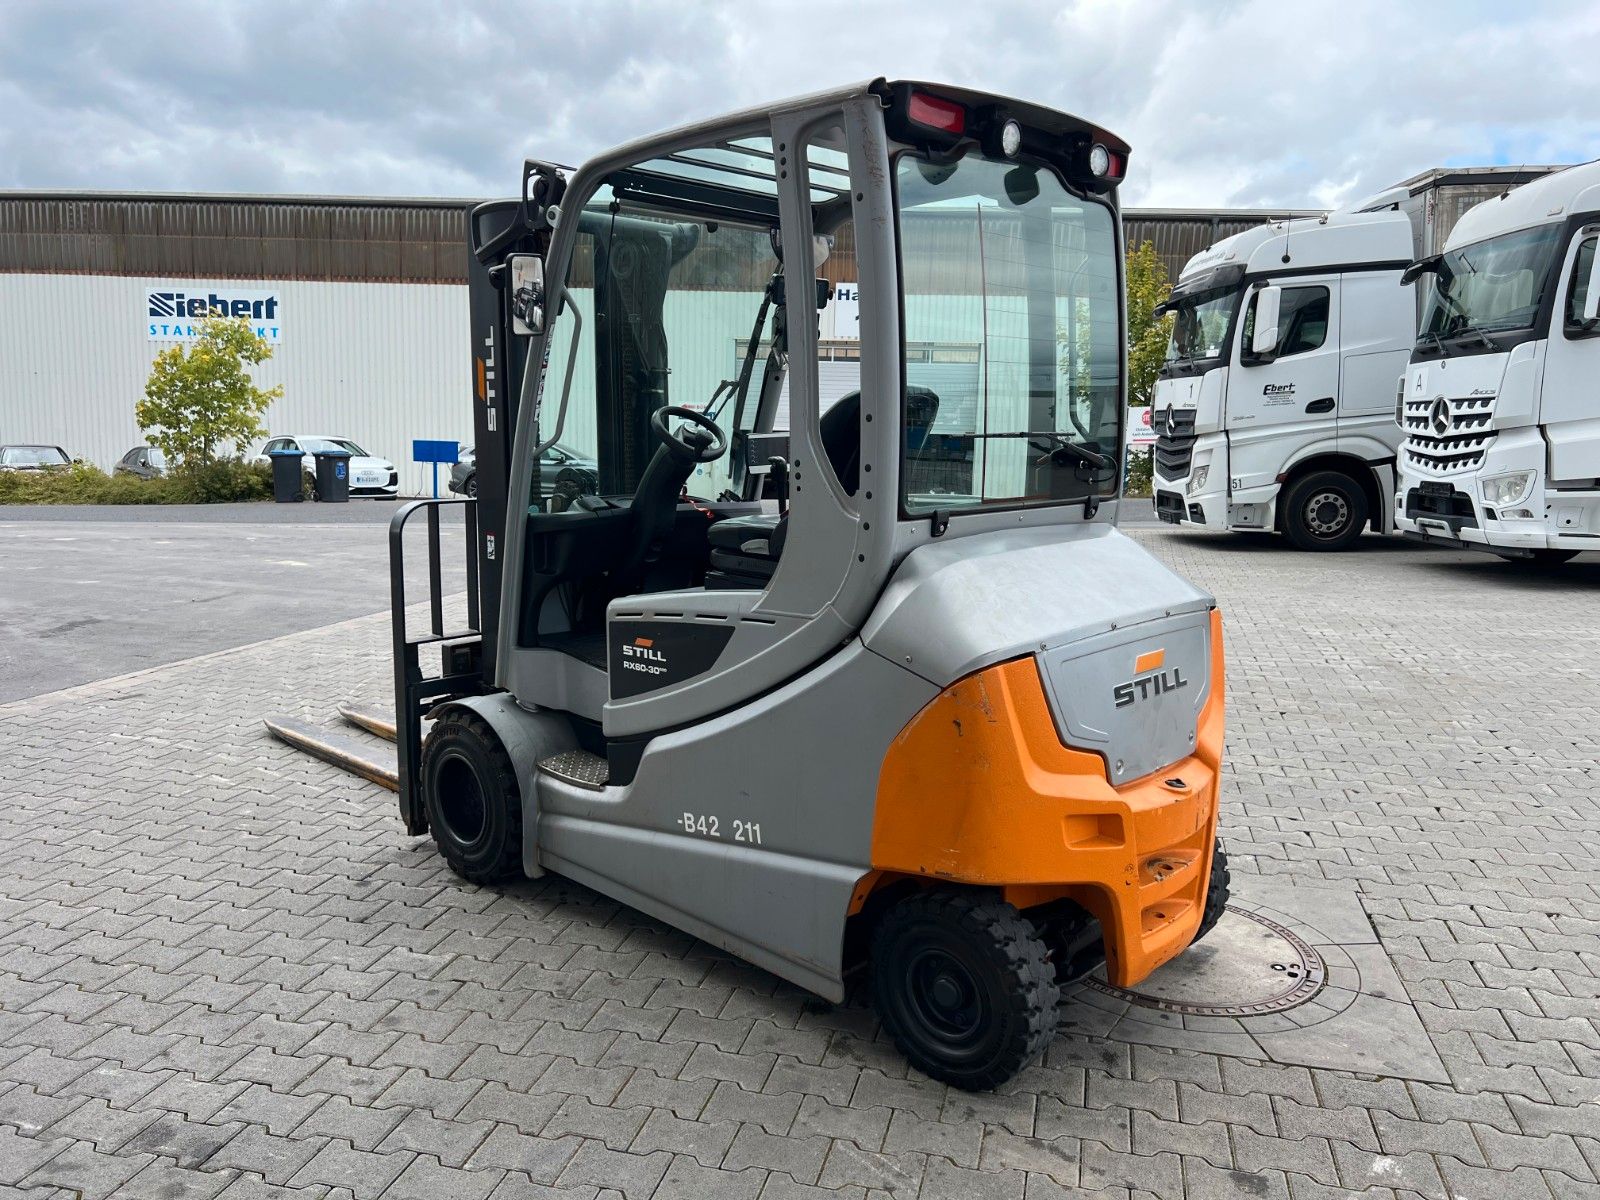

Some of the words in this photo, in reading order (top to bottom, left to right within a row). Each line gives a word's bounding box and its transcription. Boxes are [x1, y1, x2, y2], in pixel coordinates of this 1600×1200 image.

[149, 293, 278, 319] Siebert
[150, 324, 279, 338] STAHKT
[485, 326, 497, 431] STILL
[1415, 373, 1422, 391] A
[1263, 383, 1296, 395] Ebert
[1232, 479, 1242, 489] 51
[622, 644, 667, 662] STILL
[1113, 666, 1188, 709] STILL
[733, 820, 761, 844] 211
